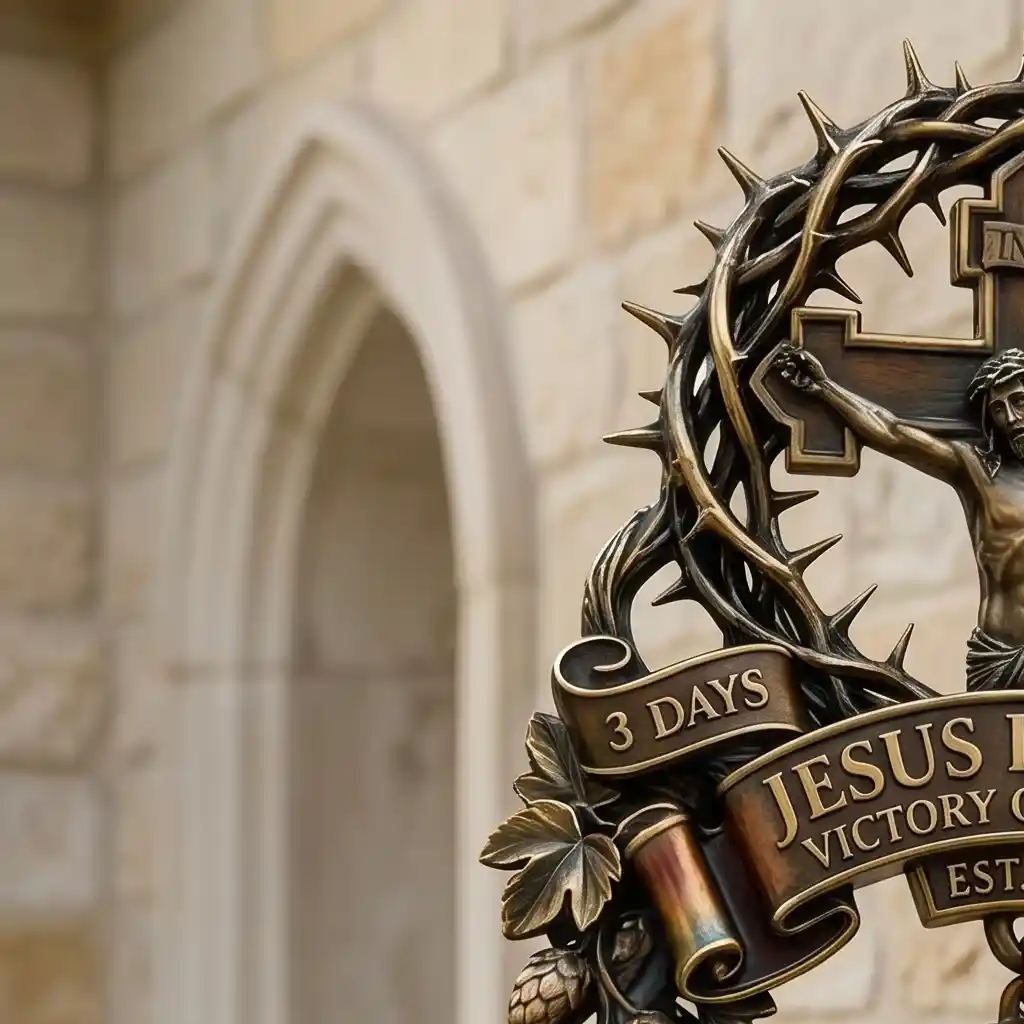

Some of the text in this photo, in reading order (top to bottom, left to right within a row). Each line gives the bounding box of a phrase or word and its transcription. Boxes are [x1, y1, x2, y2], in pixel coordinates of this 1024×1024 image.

[605, 668, 770, 752] 3 DAYS
[762, 717, 983, 849] JESUS
[801, 788, 997, 869] VICTORY
